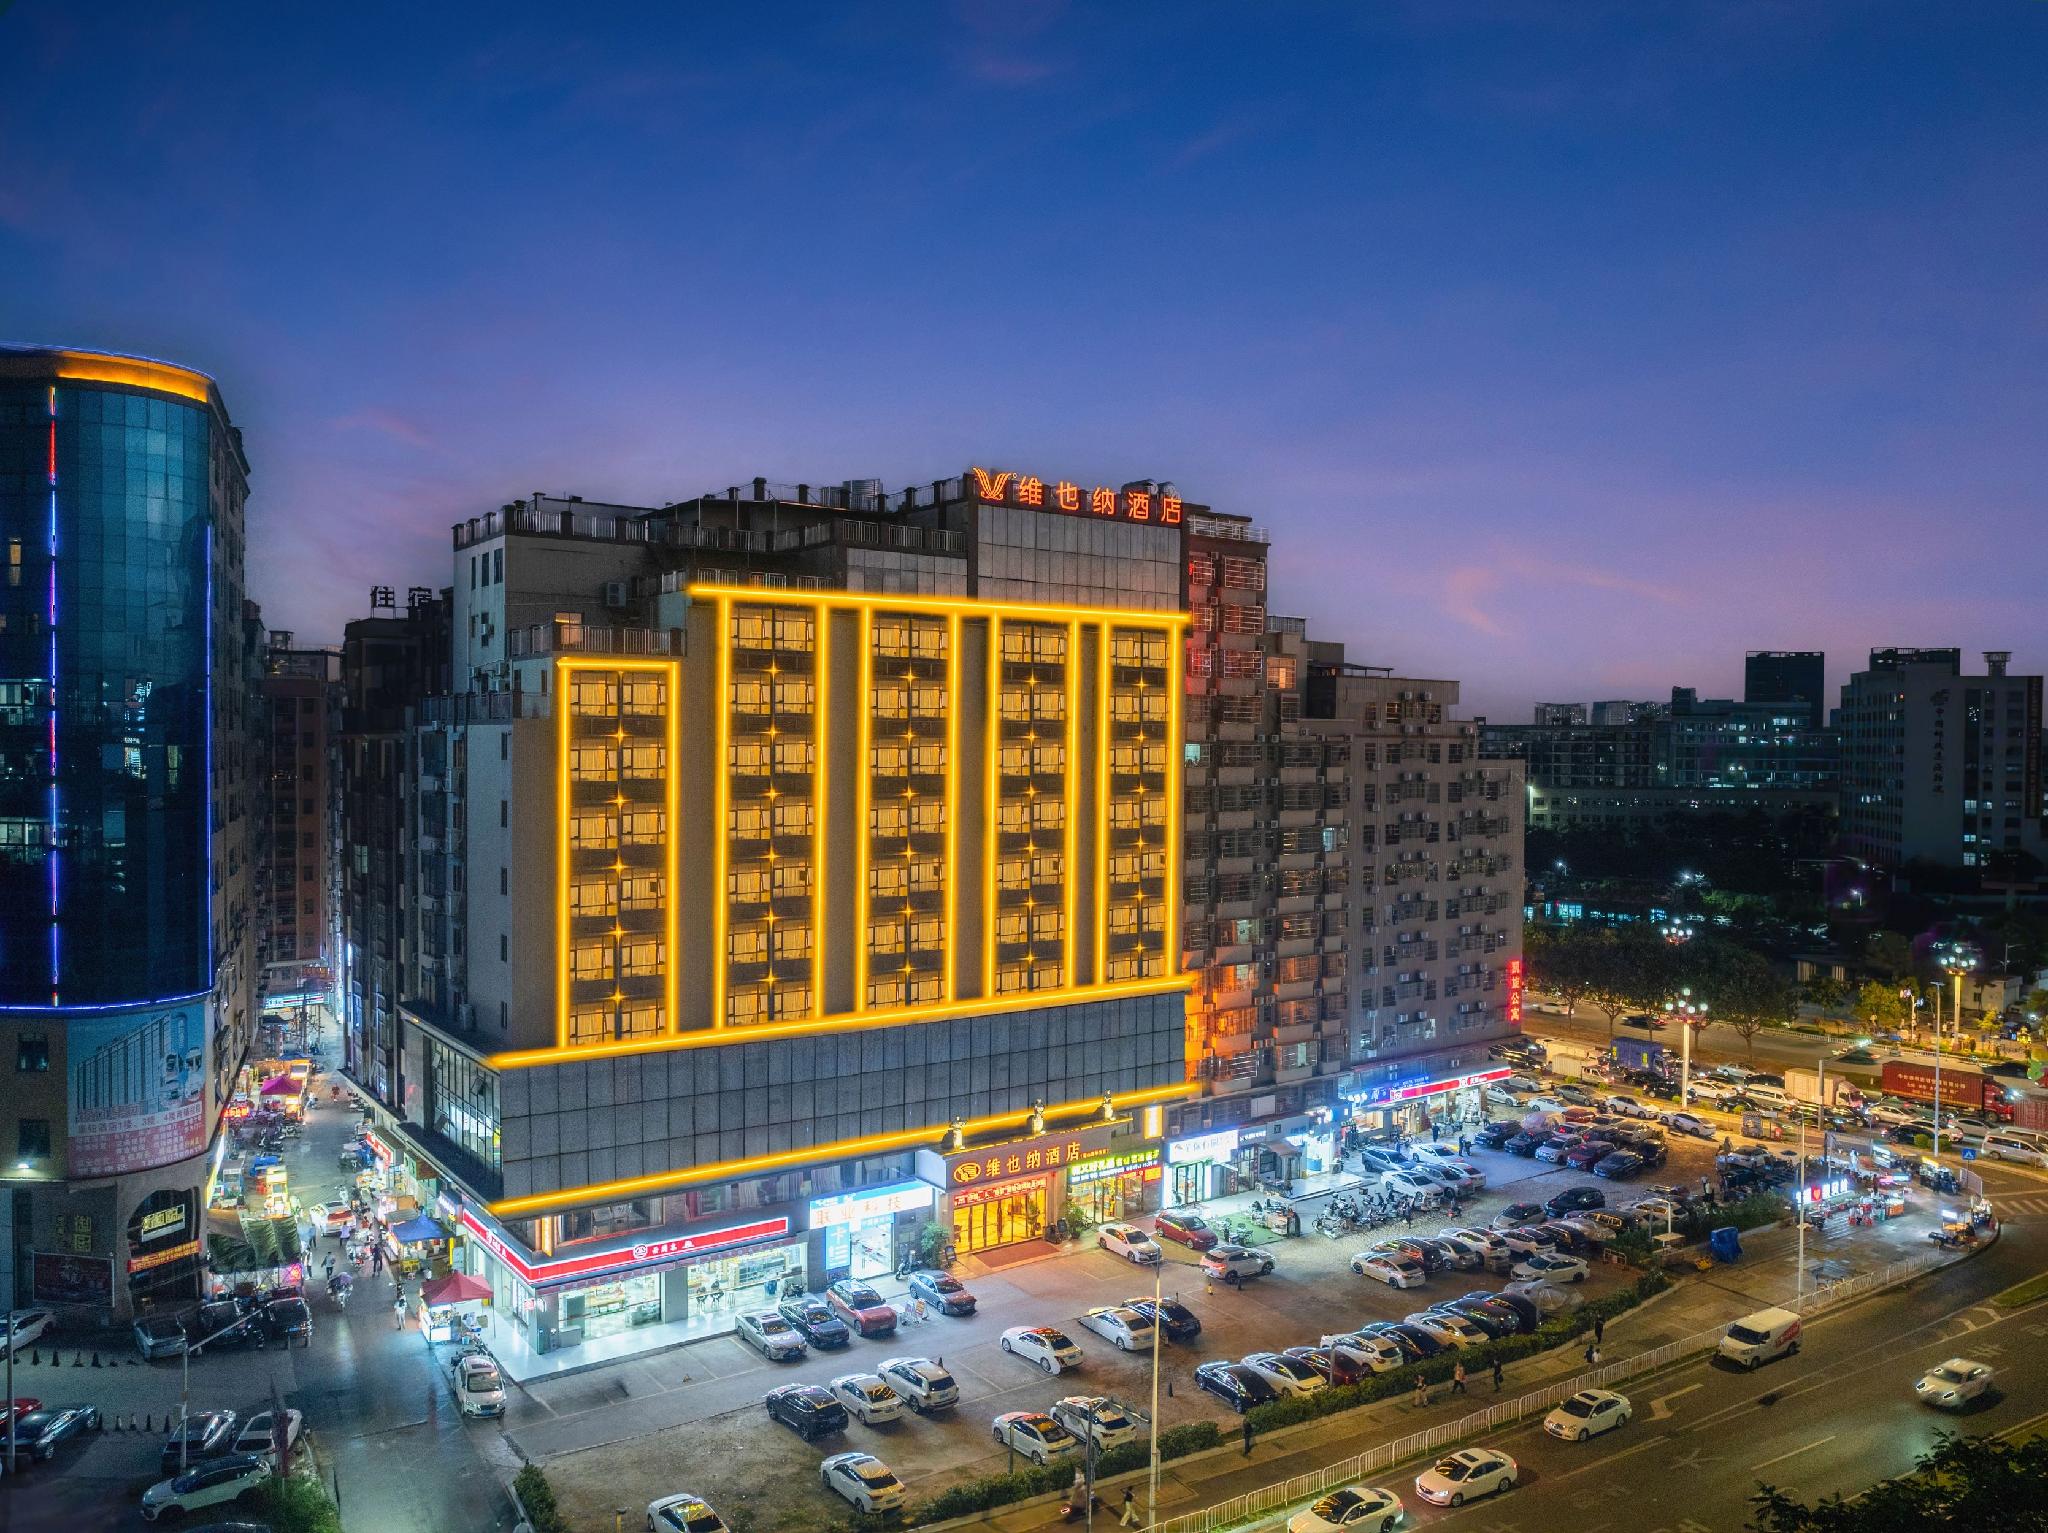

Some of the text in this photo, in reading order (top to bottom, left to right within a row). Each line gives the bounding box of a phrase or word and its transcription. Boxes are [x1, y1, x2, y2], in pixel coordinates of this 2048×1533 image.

[1019, 477, 1183, 524] 维也纳酒店
[370, 586, 432, 607] 住宿
[985, 1141, 1081, 1177] 维也纳酒店
